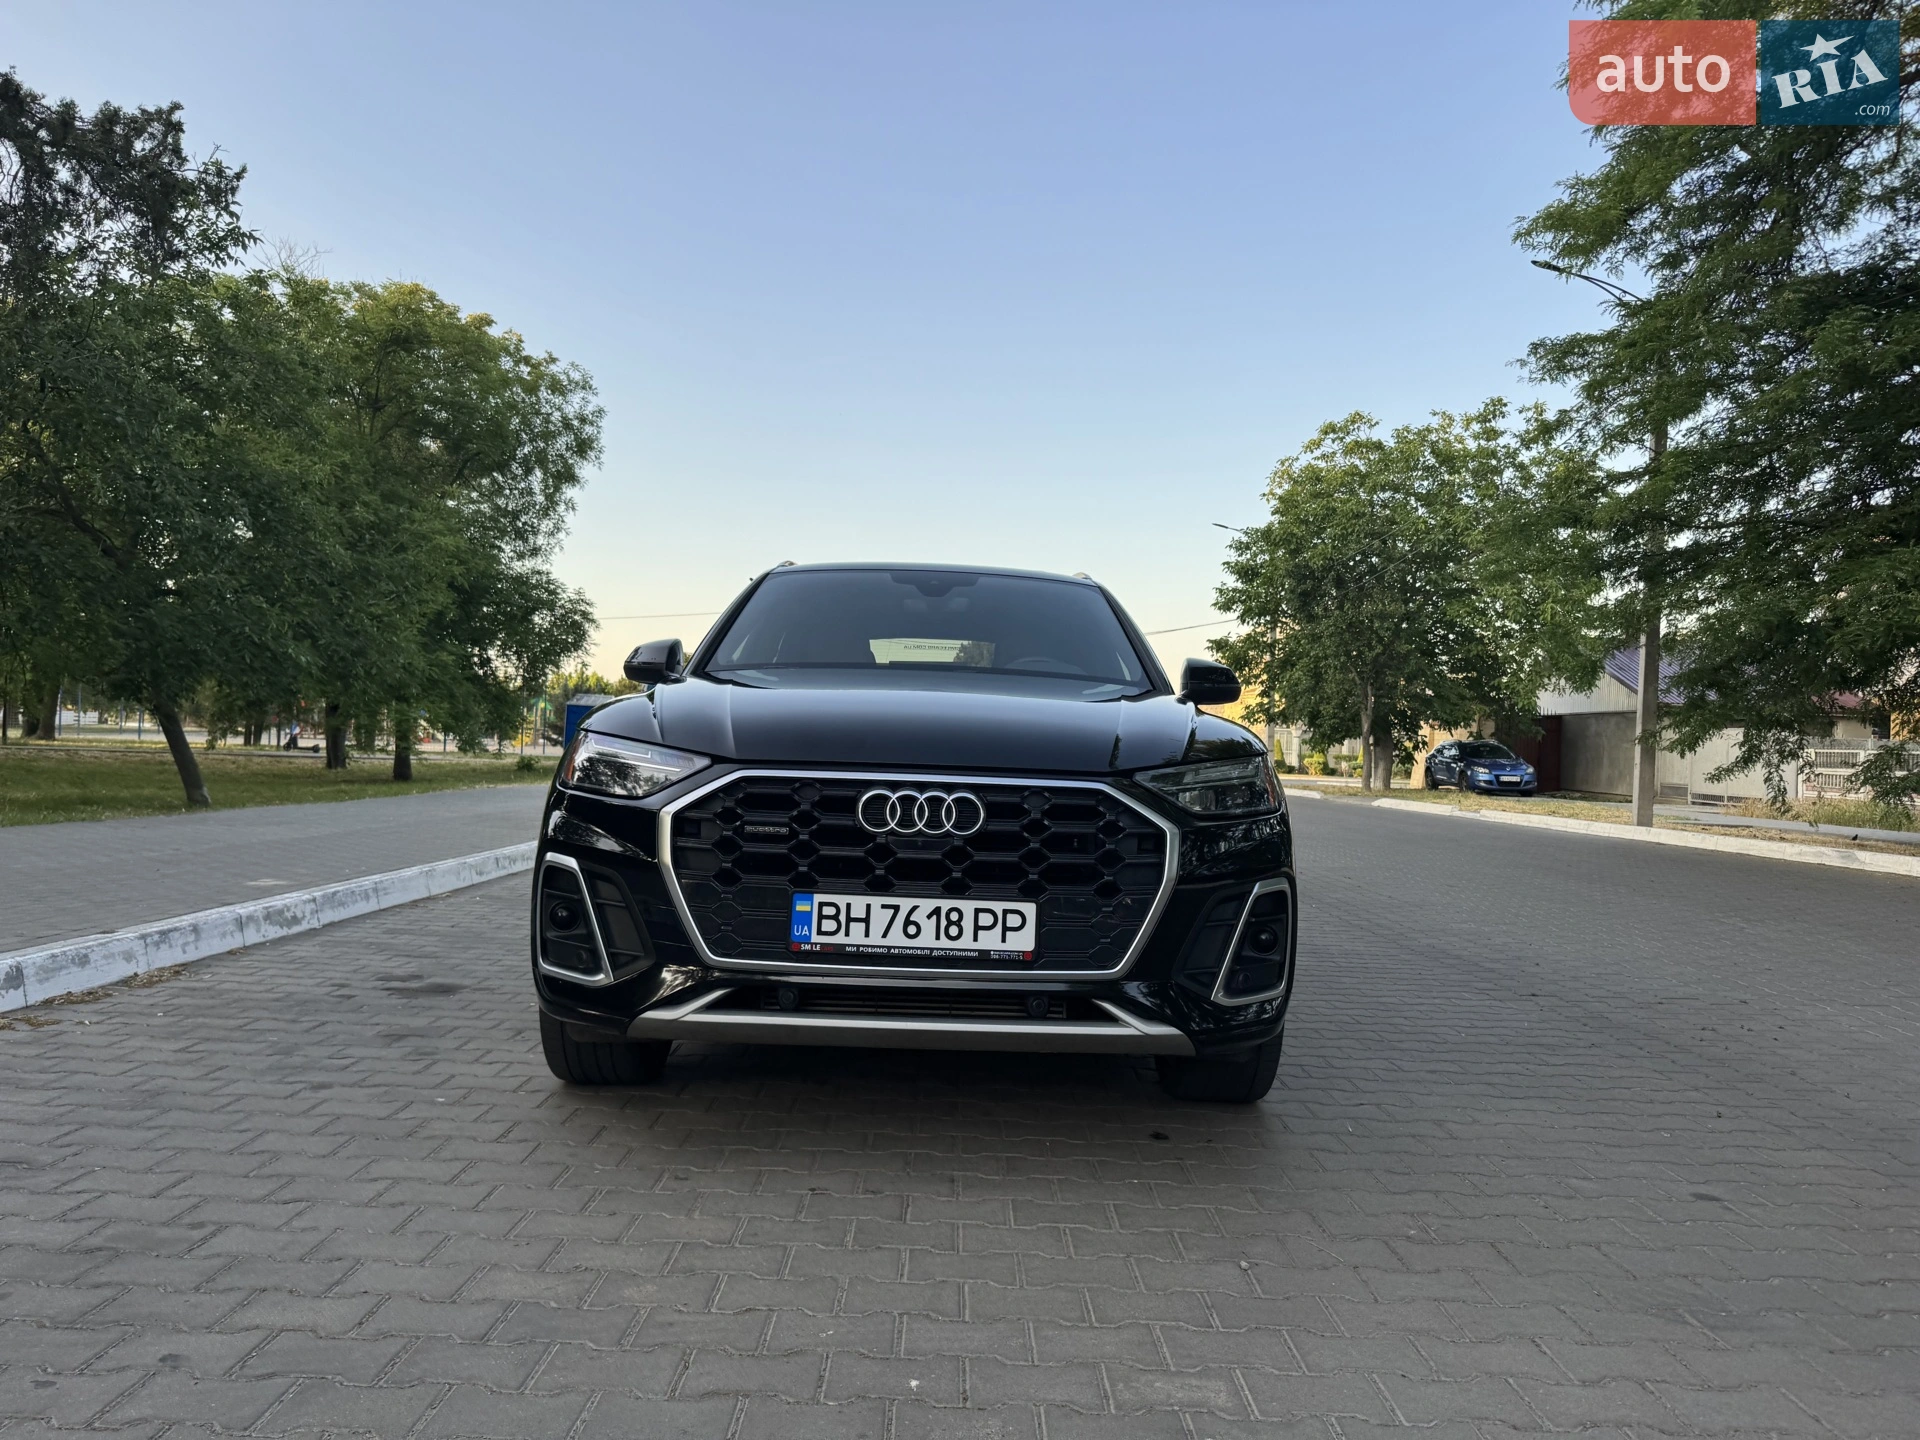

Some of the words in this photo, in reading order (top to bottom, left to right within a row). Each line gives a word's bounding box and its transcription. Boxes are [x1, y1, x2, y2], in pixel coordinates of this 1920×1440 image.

[794, 924, 810, 936] UA
[801, 943, 821, 951] SMLE
[890, 947, 930, 955] АВТОМОБІЛІ
[932, 949, 979, 957] ДОСТУПНИМИ
